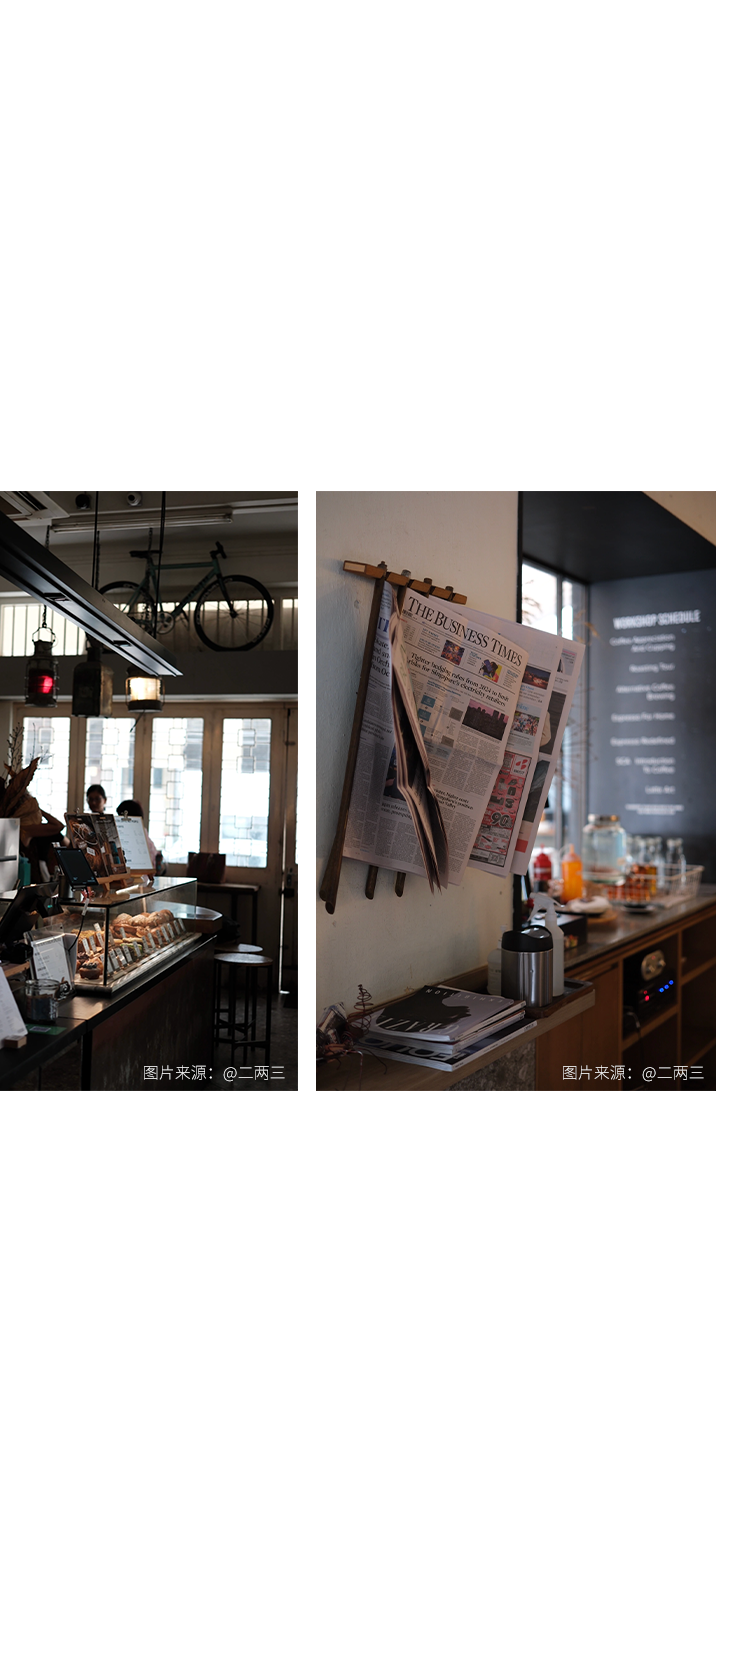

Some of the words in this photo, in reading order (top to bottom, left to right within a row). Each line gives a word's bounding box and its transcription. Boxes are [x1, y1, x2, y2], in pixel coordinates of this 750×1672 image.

[658, 609, 702, 626] SCHEDULE
[408, 596, 435, 624] THE
[434, 612, 490, 649] BUSINESS
[490, 637, 522, 667] TIMES
[411, 652, 430, 665] Tighter
